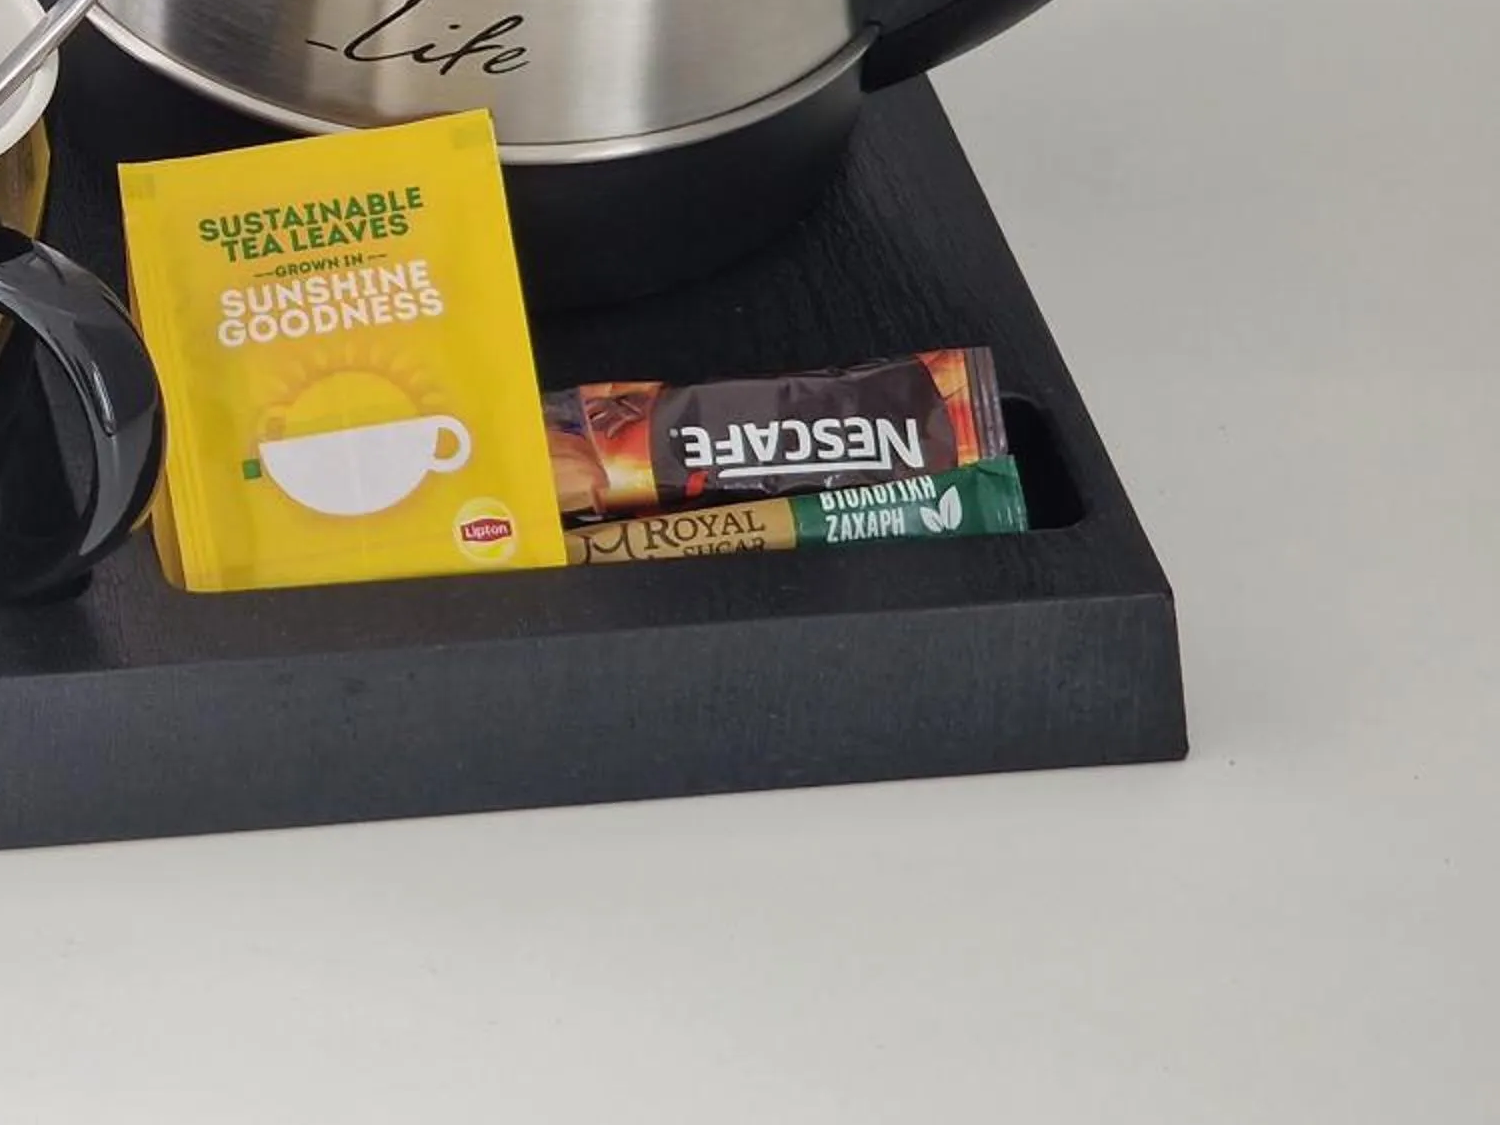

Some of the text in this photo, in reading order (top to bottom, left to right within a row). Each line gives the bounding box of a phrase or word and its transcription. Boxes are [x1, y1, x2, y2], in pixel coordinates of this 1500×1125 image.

[198, 186, 424, 243] SUSTAINABLE
[220, 213, 409, 263] TEA LEAVES
[219, 259, 431, 318] SUNSHINE
[275, 252, 364, 278] GROWN IN
[217, 287, 445, 348] GOODNESS
[464, 523, 509, 541] Lipton
[642, 509, 766, 551] ROYAL
